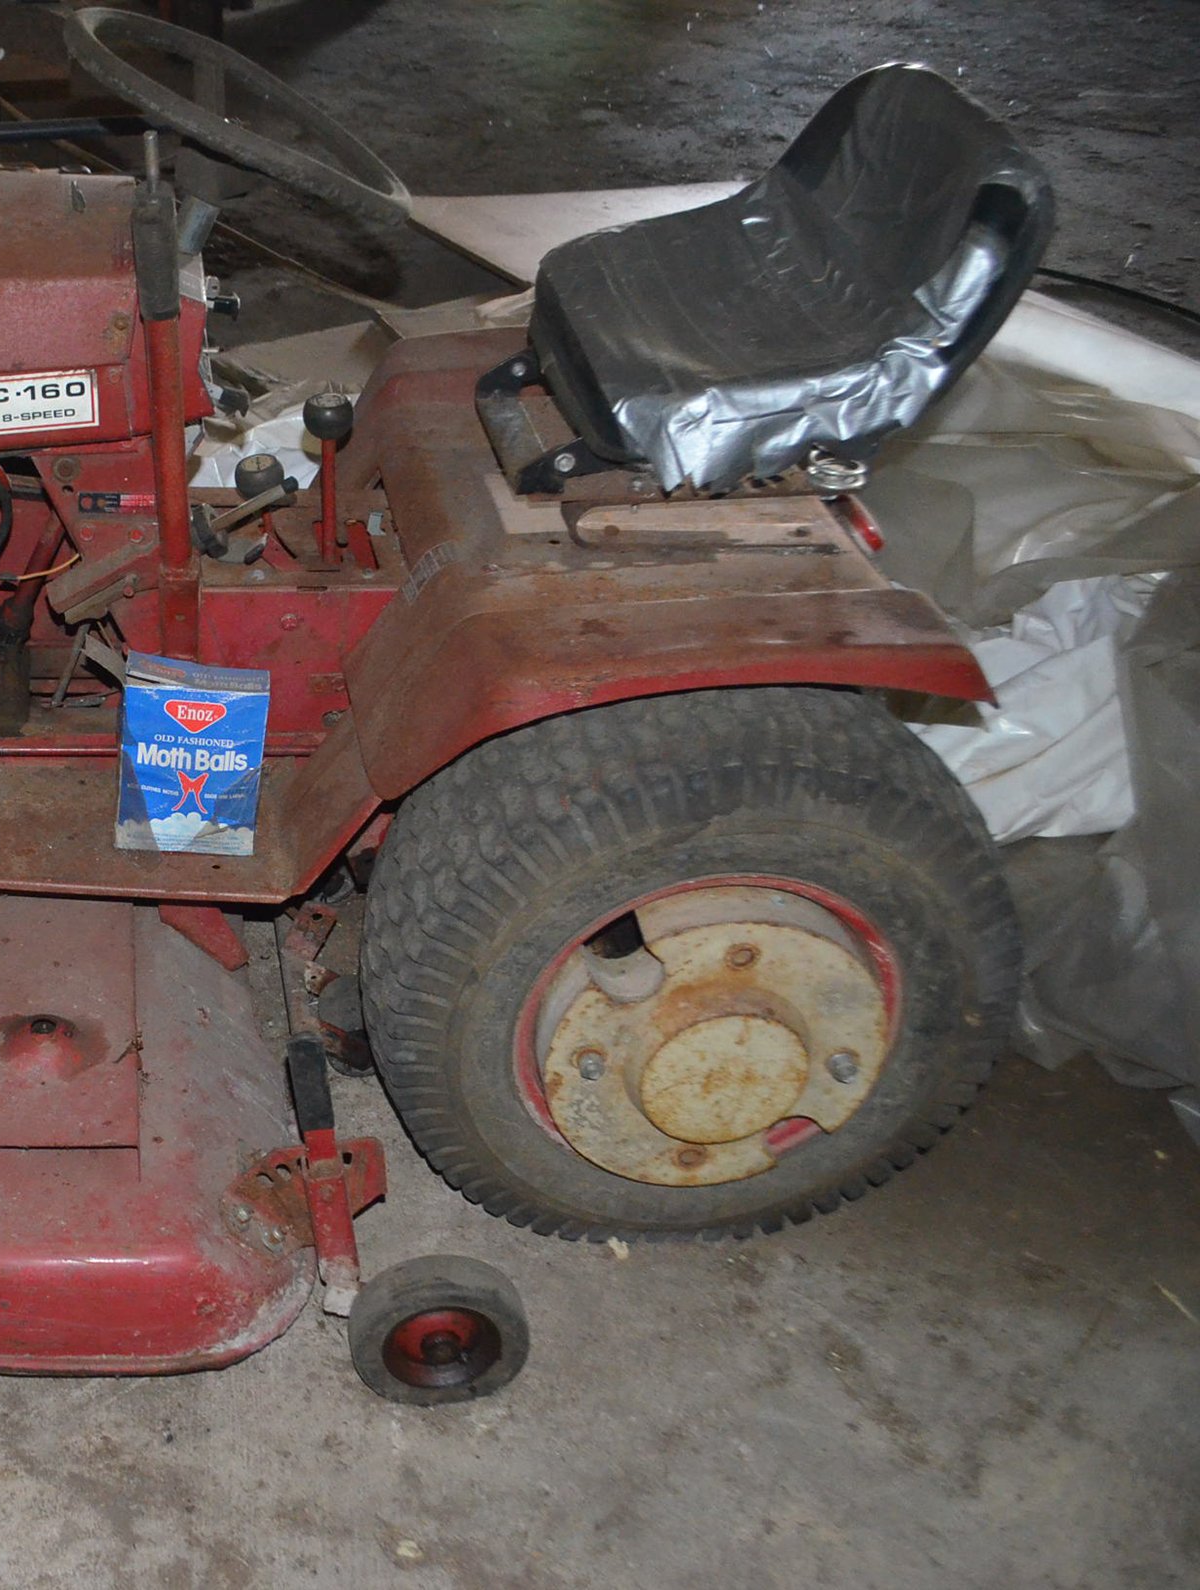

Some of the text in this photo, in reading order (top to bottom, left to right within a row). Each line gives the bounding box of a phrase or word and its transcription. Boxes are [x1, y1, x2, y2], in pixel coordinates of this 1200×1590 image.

[2, 408, 76, 422] 8-SPEED
[177, 704, 214, 721] Enoz
[154, 733, 234, 749] OLD FASHIONED
[136, 742, 248, 772] Moth Balls
